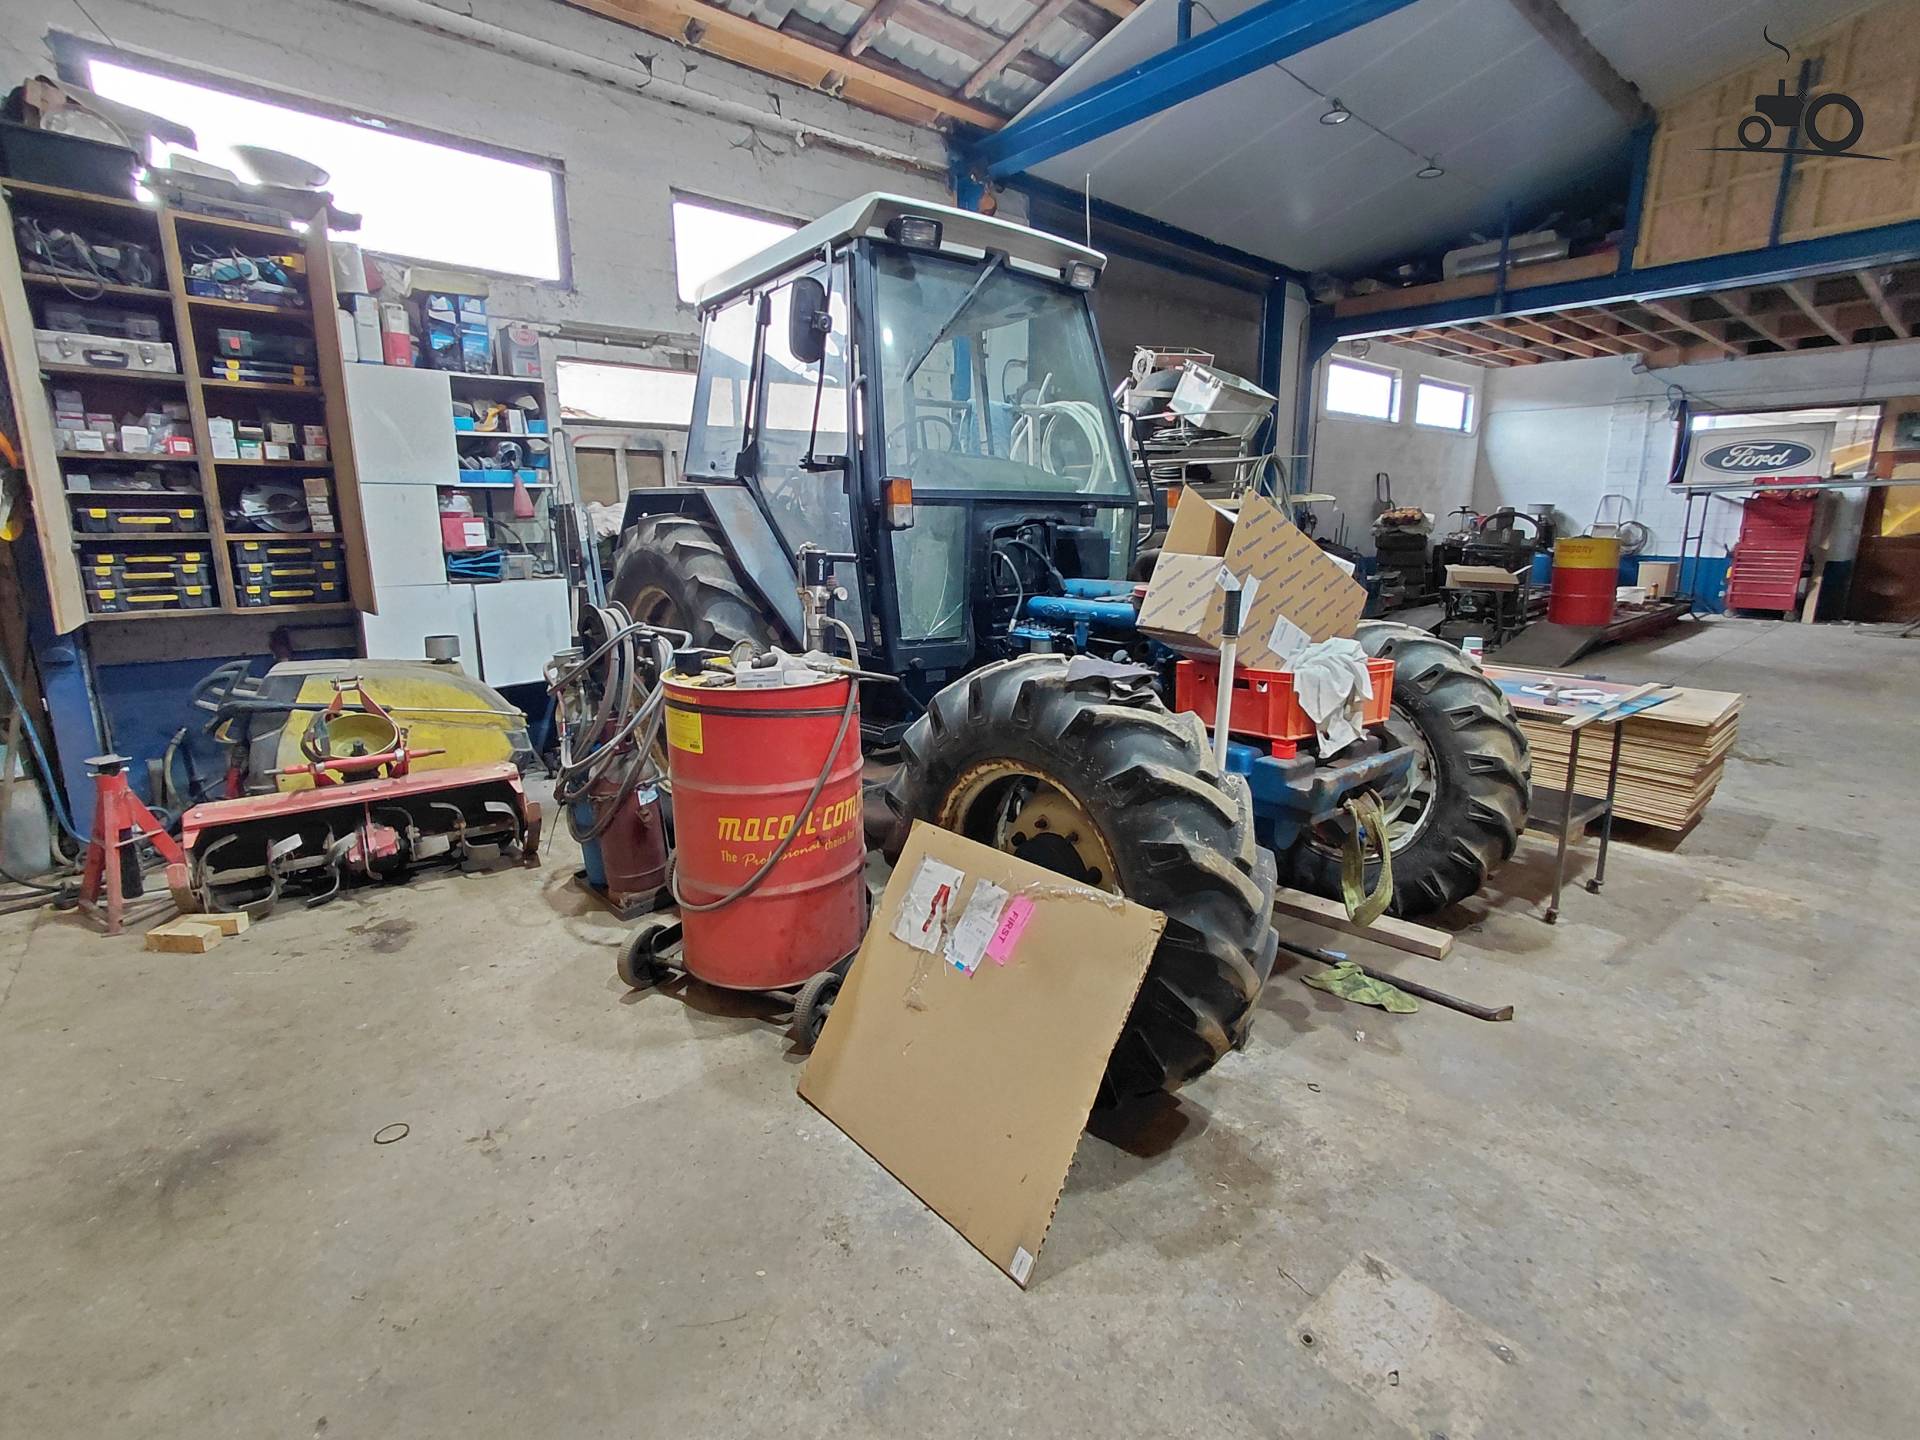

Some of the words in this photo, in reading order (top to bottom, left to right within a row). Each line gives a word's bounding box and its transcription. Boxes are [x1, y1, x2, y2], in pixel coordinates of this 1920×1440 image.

[1721, 444, 1792, 468] Ford
[720, 850, 738, 863] The
[742, 840, 821, 868] Profsional
[1000, 911, 1019, 944] FIRST
